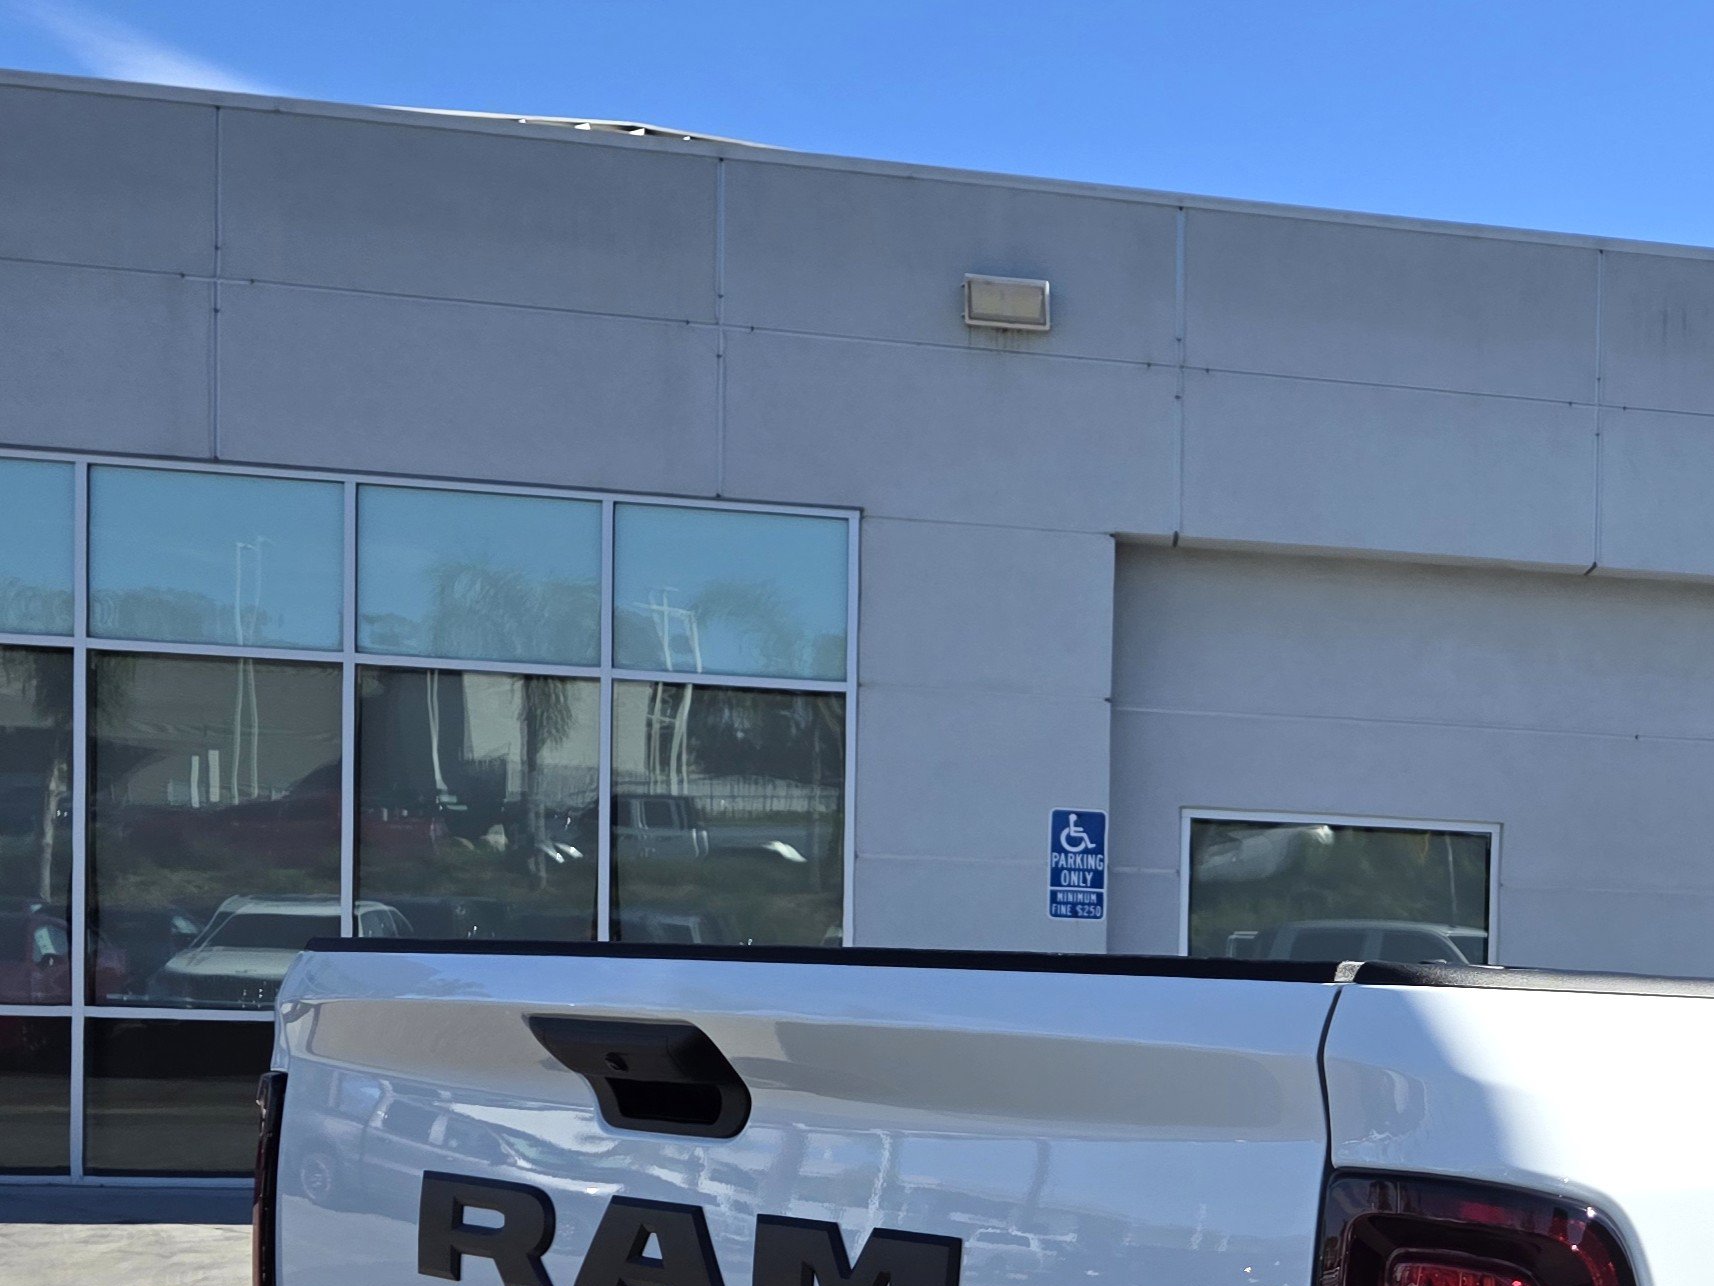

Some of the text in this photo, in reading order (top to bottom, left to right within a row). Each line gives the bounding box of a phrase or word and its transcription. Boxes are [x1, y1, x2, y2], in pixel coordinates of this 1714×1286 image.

[1051, 852, 1104, 870] PARKING
[1060, 870, 1094, 887] ONLY
[1056, 892, 1097, 903] MINIMUM
[1052, 903, 1102, 917] FINE $250
